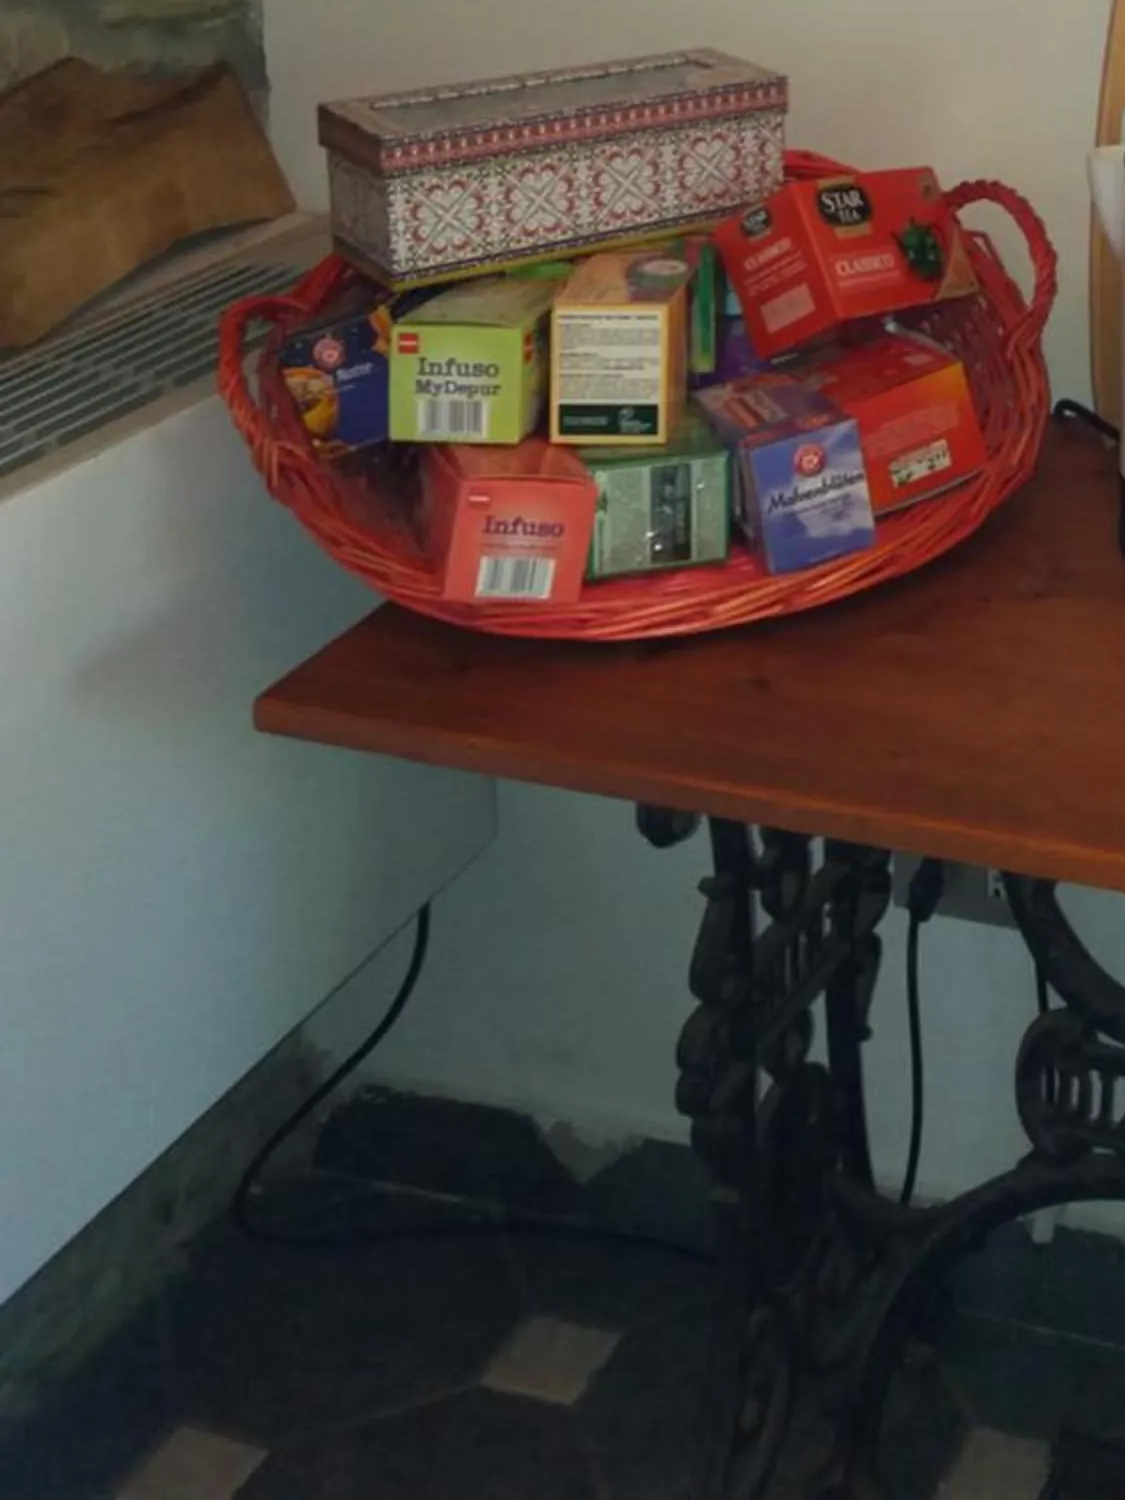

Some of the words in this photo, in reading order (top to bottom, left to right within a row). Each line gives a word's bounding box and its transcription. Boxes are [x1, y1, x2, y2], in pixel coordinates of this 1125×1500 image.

[417, 355, 500, 378] Infuso
[415, 378, 503, 399] MyDepur
[481, 514, 566, 538] Infuso
